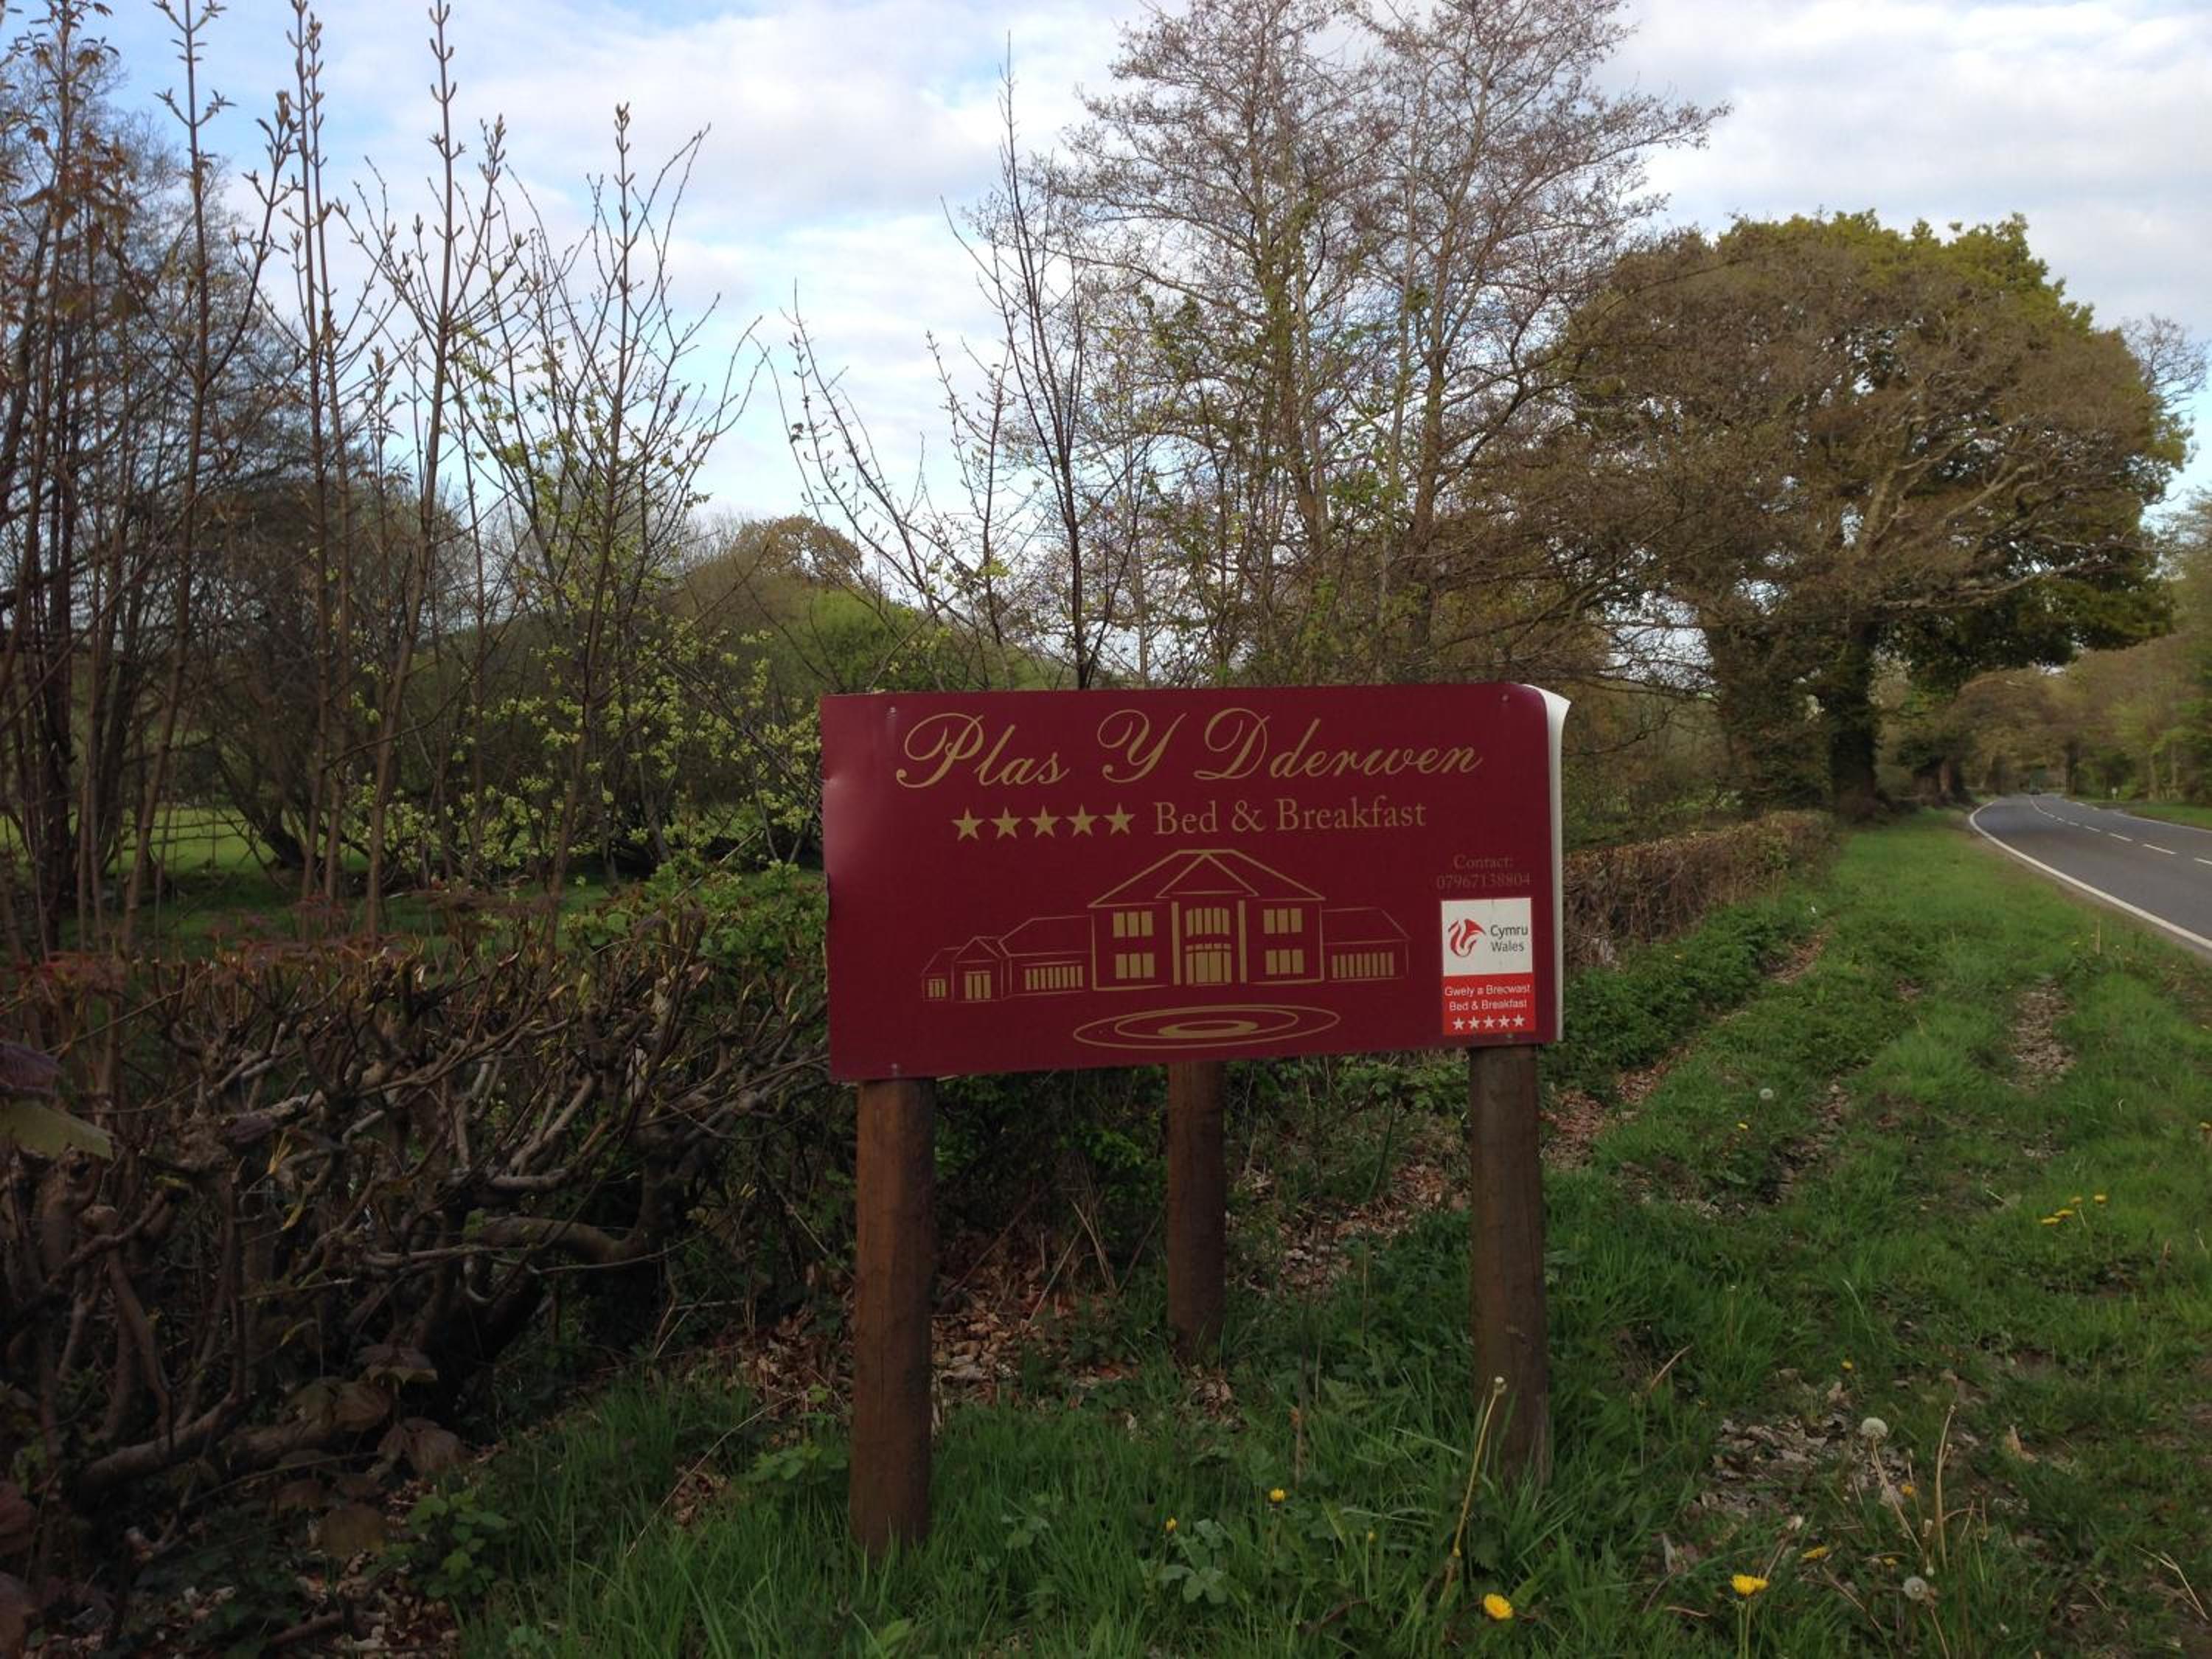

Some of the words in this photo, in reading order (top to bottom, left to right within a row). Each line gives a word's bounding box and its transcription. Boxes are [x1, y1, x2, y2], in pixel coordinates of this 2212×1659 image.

[896, 712, 1070, 789] Plas
[1097, 709, 1186, 783] Y
[1193, 706, 1484, 781] Dderwen
[1154, 801, 1219, 835] Bed
[1231, 799, 1267, 833] &
[1276, 795, 1427, 832] Breakfast
[1490, 924, 1528, 939] Cymru
[1490, 941, 1525, 953] Wales
[1444, 986, 1474, 997] Gwely
[1486, 984, 1531, 995] Brecwast
[1449, 1001, 1469, 1011] Bed
[1471, 1000, 1479, 1010] &
[1481, 998, 1528, 1010] Breakfast
